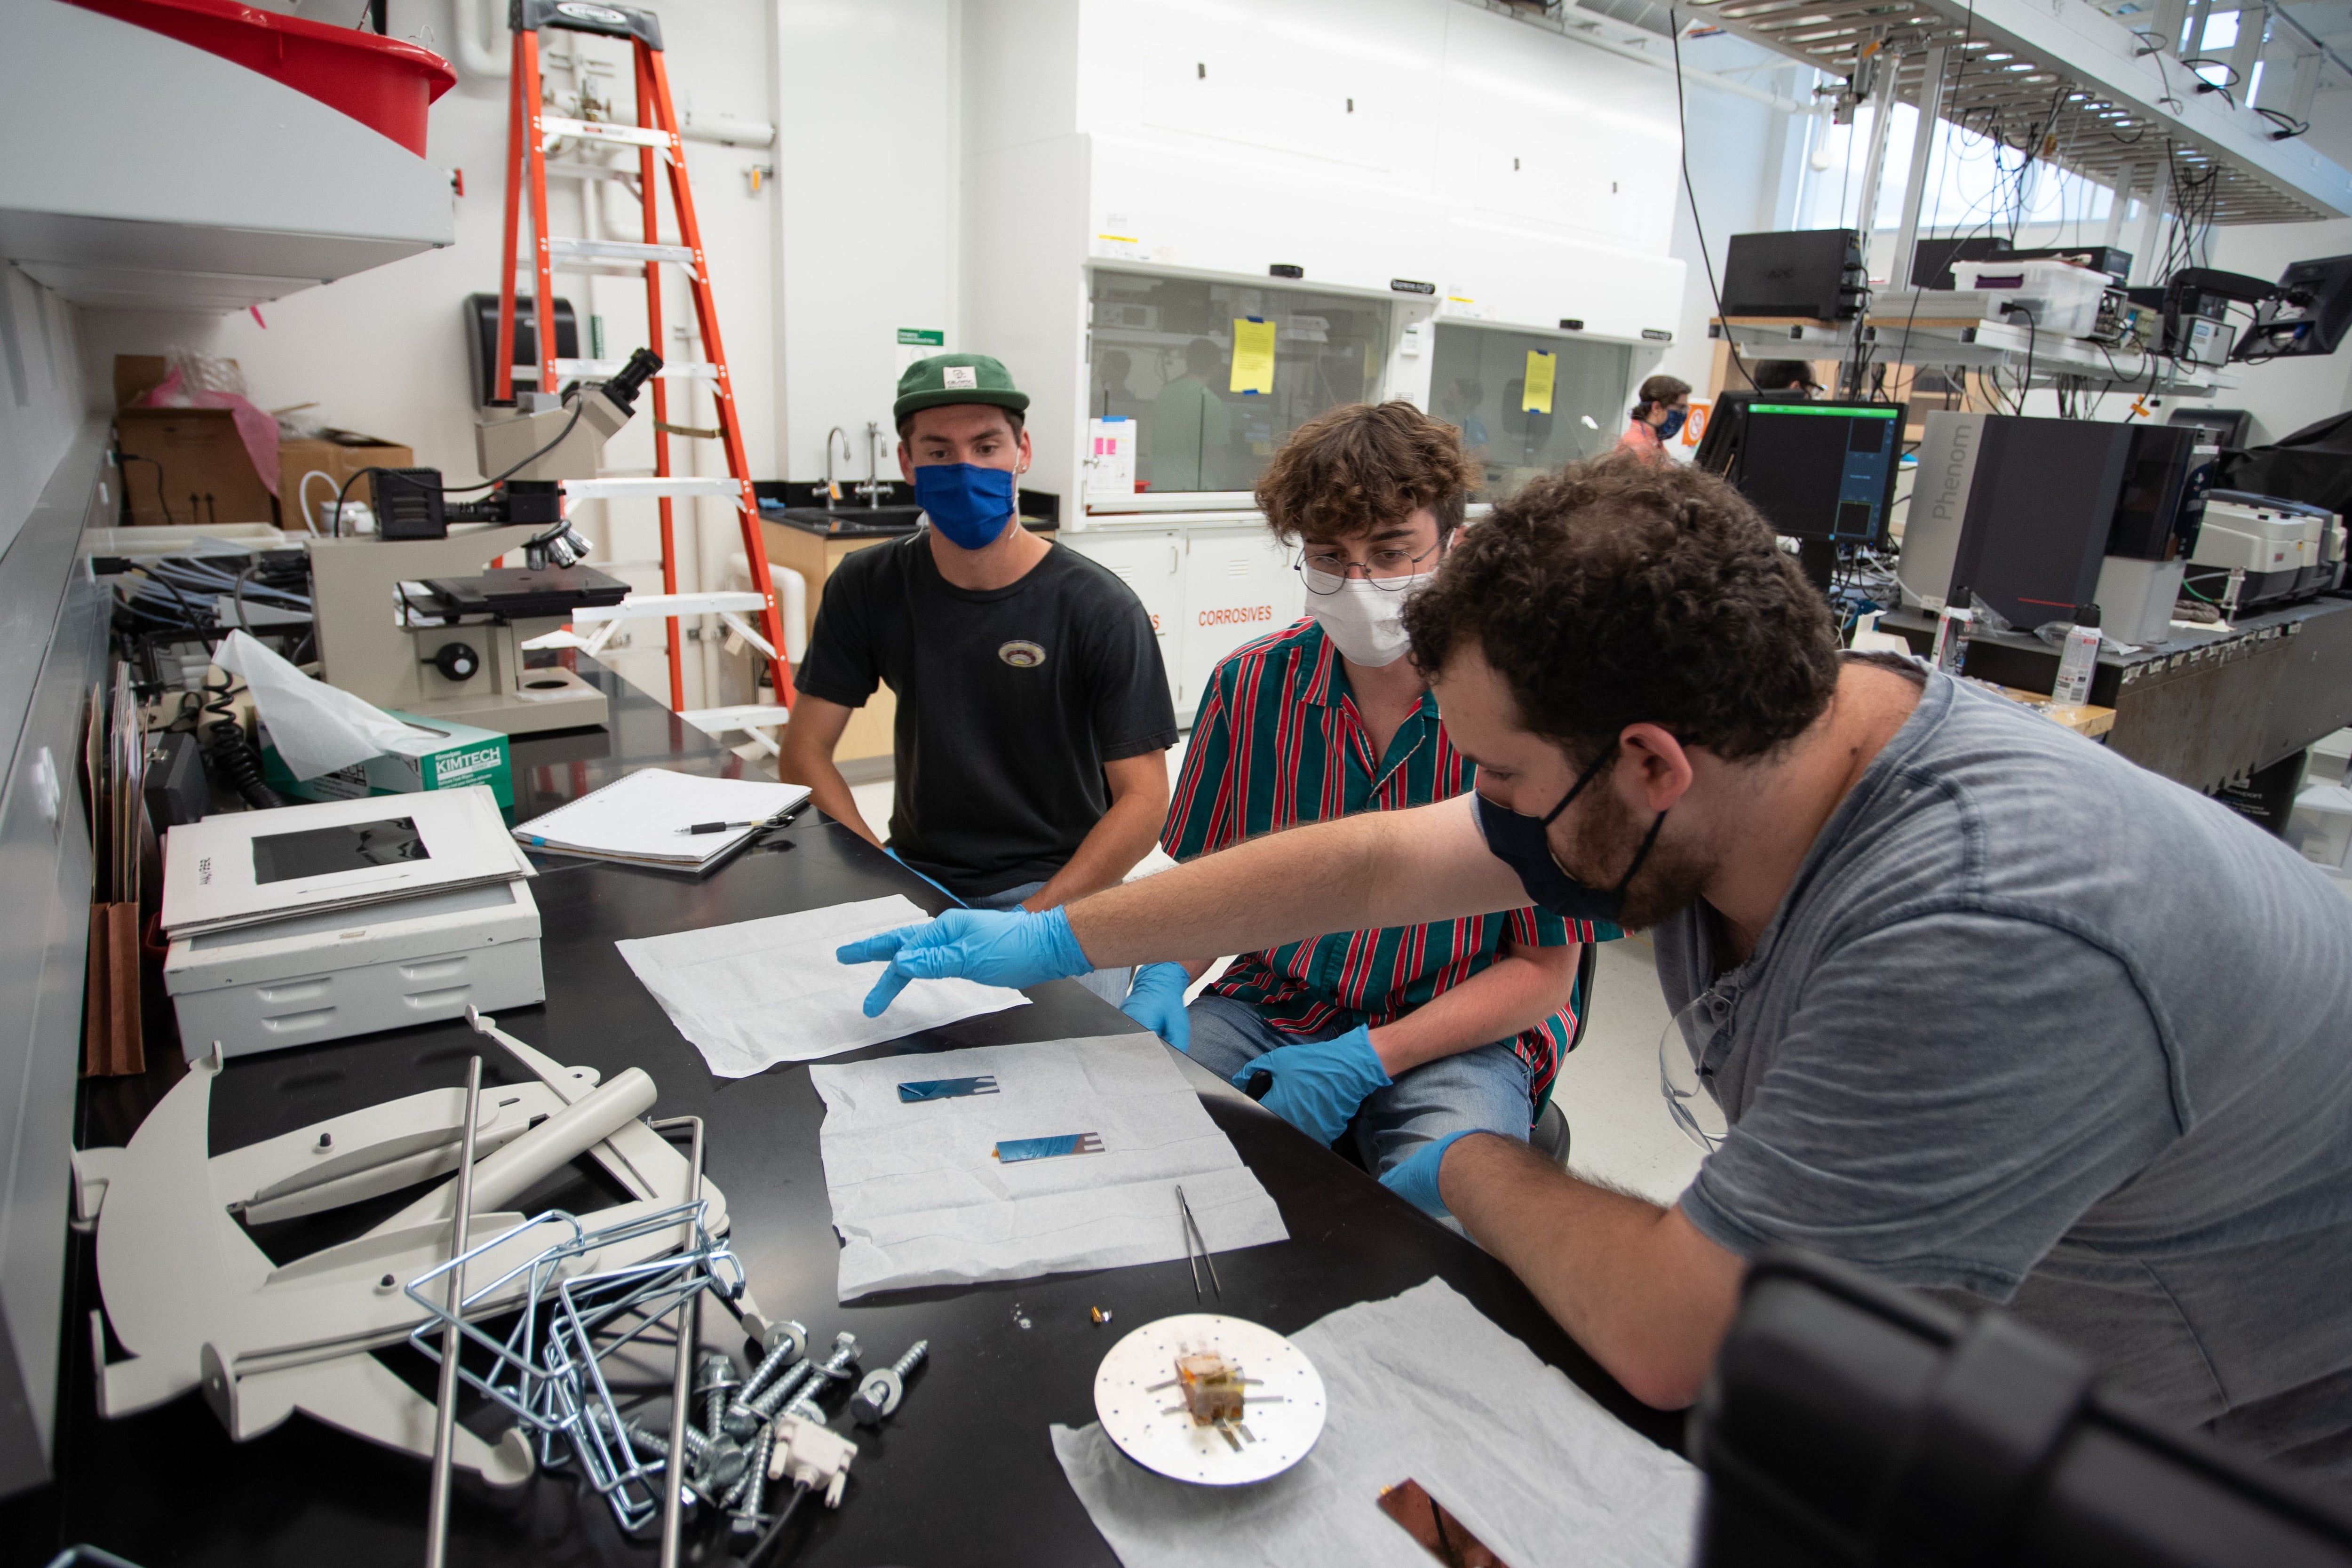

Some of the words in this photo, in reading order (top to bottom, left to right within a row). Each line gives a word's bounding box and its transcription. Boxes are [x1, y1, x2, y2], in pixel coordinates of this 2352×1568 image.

[1932, 425, 1972, 519] Phenom
[1199, 605, 1272, 626] CORROSIVES
[436, 746, 501, 774] KIMTECH
